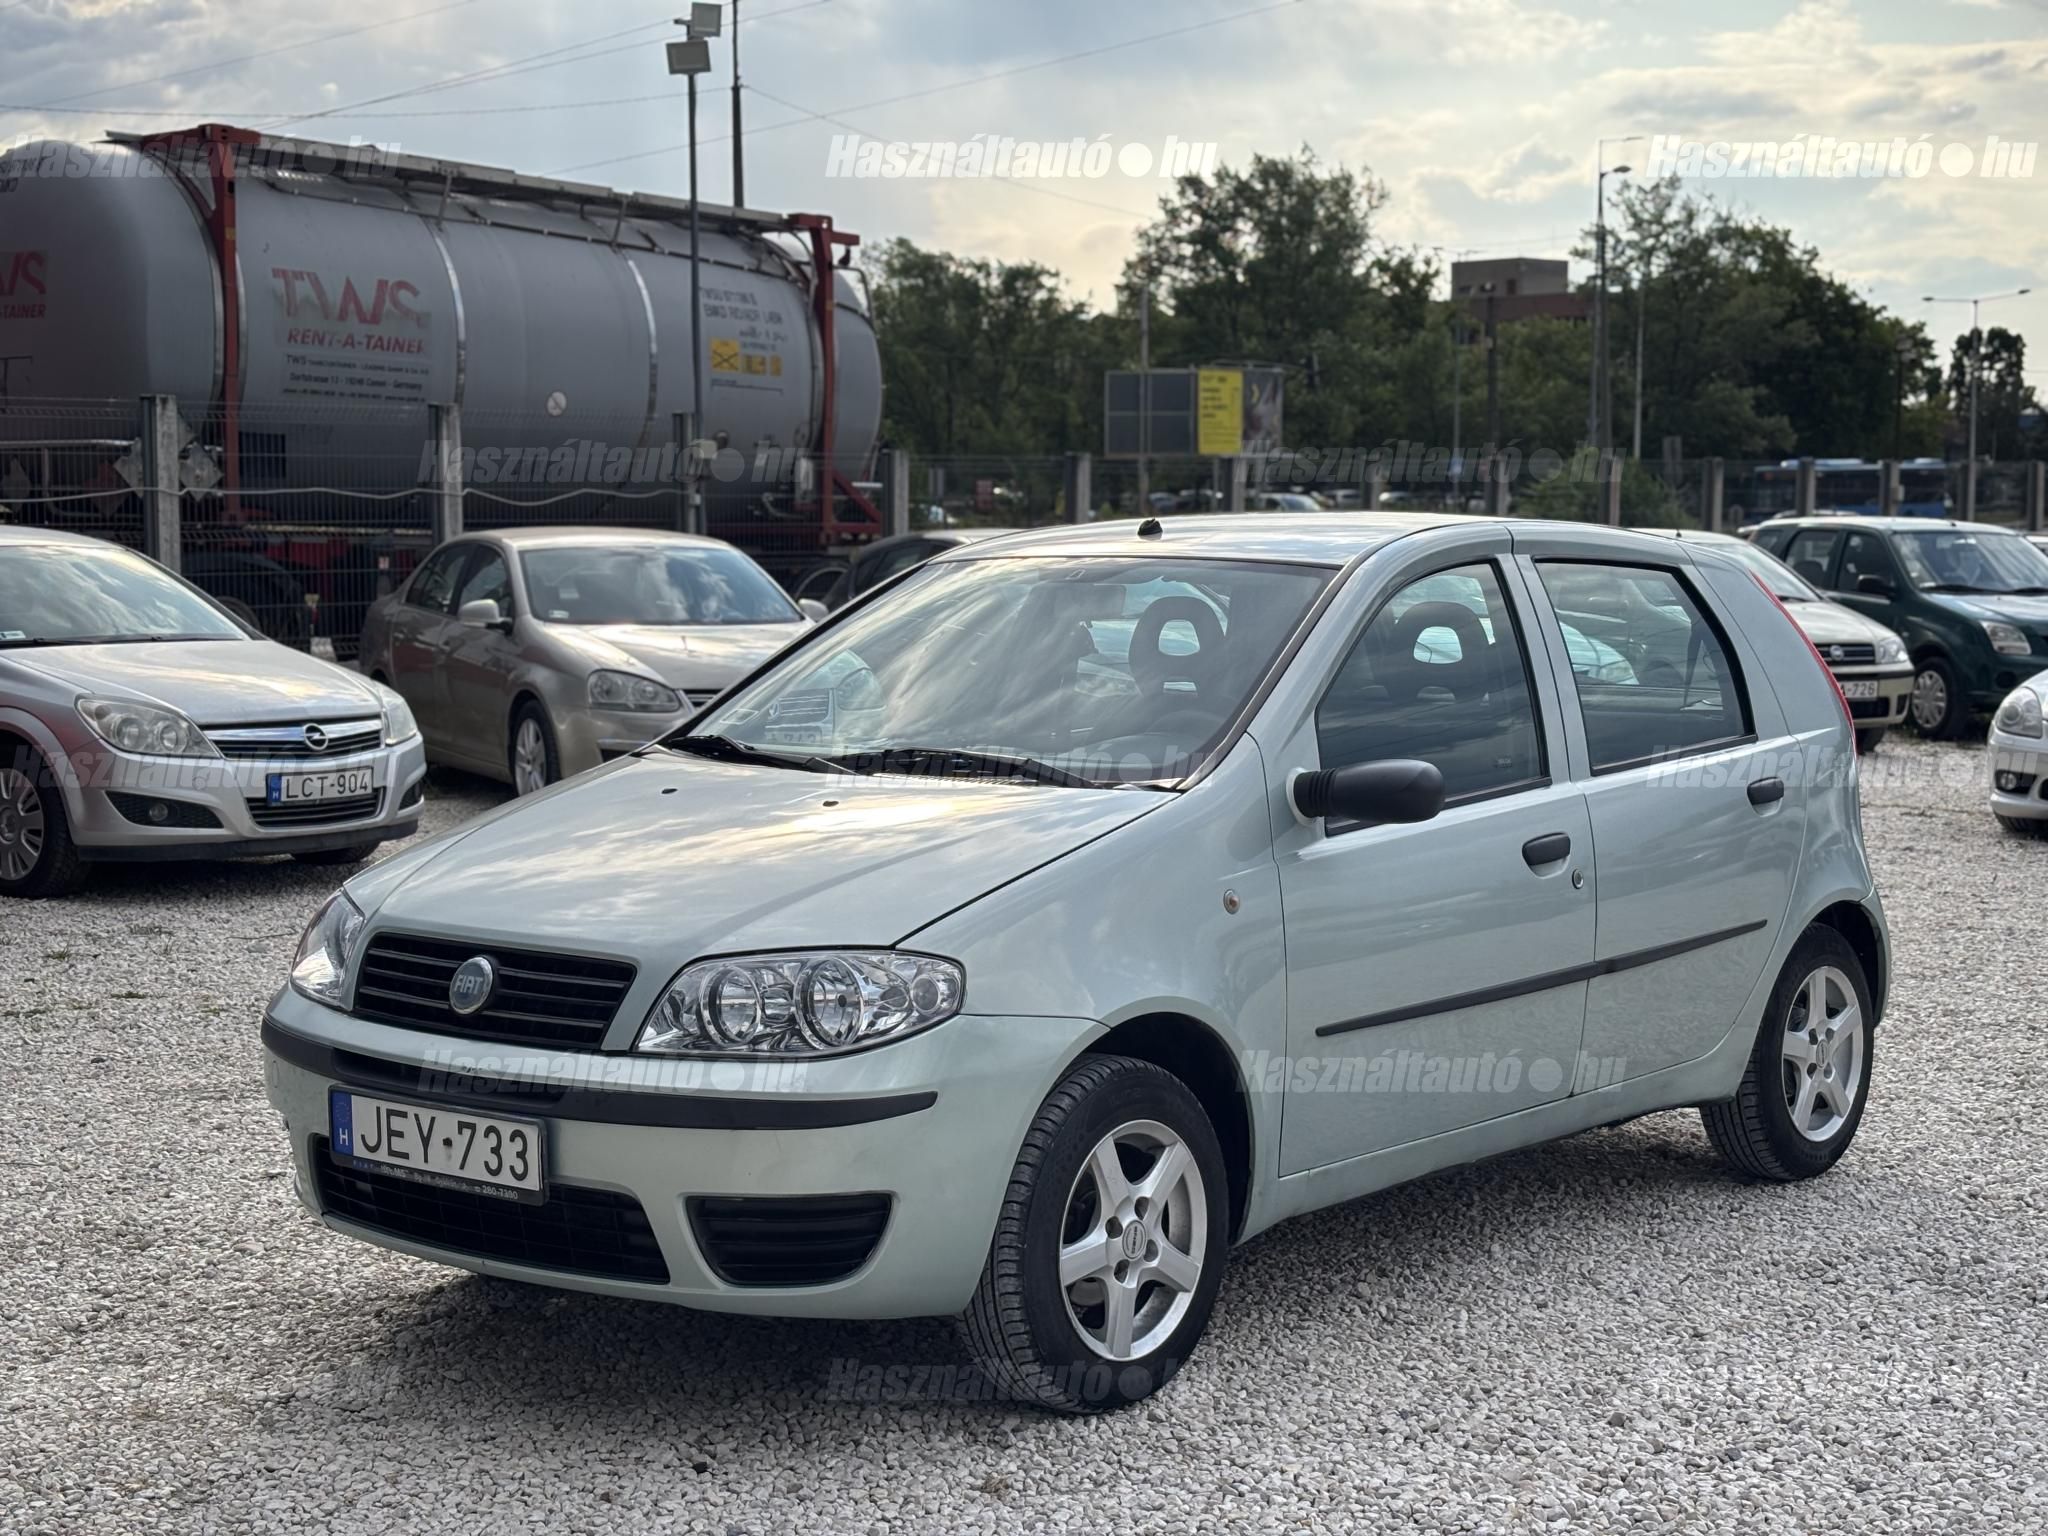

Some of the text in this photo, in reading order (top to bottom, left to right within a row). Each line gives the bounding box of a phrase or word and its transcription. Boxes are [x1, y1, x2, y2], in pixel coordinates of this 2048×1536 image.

[286, 773, 369, 799] LCT-904
[454, 974, 484, 995] FIAT
[339, 1128, 348, 1146] H
